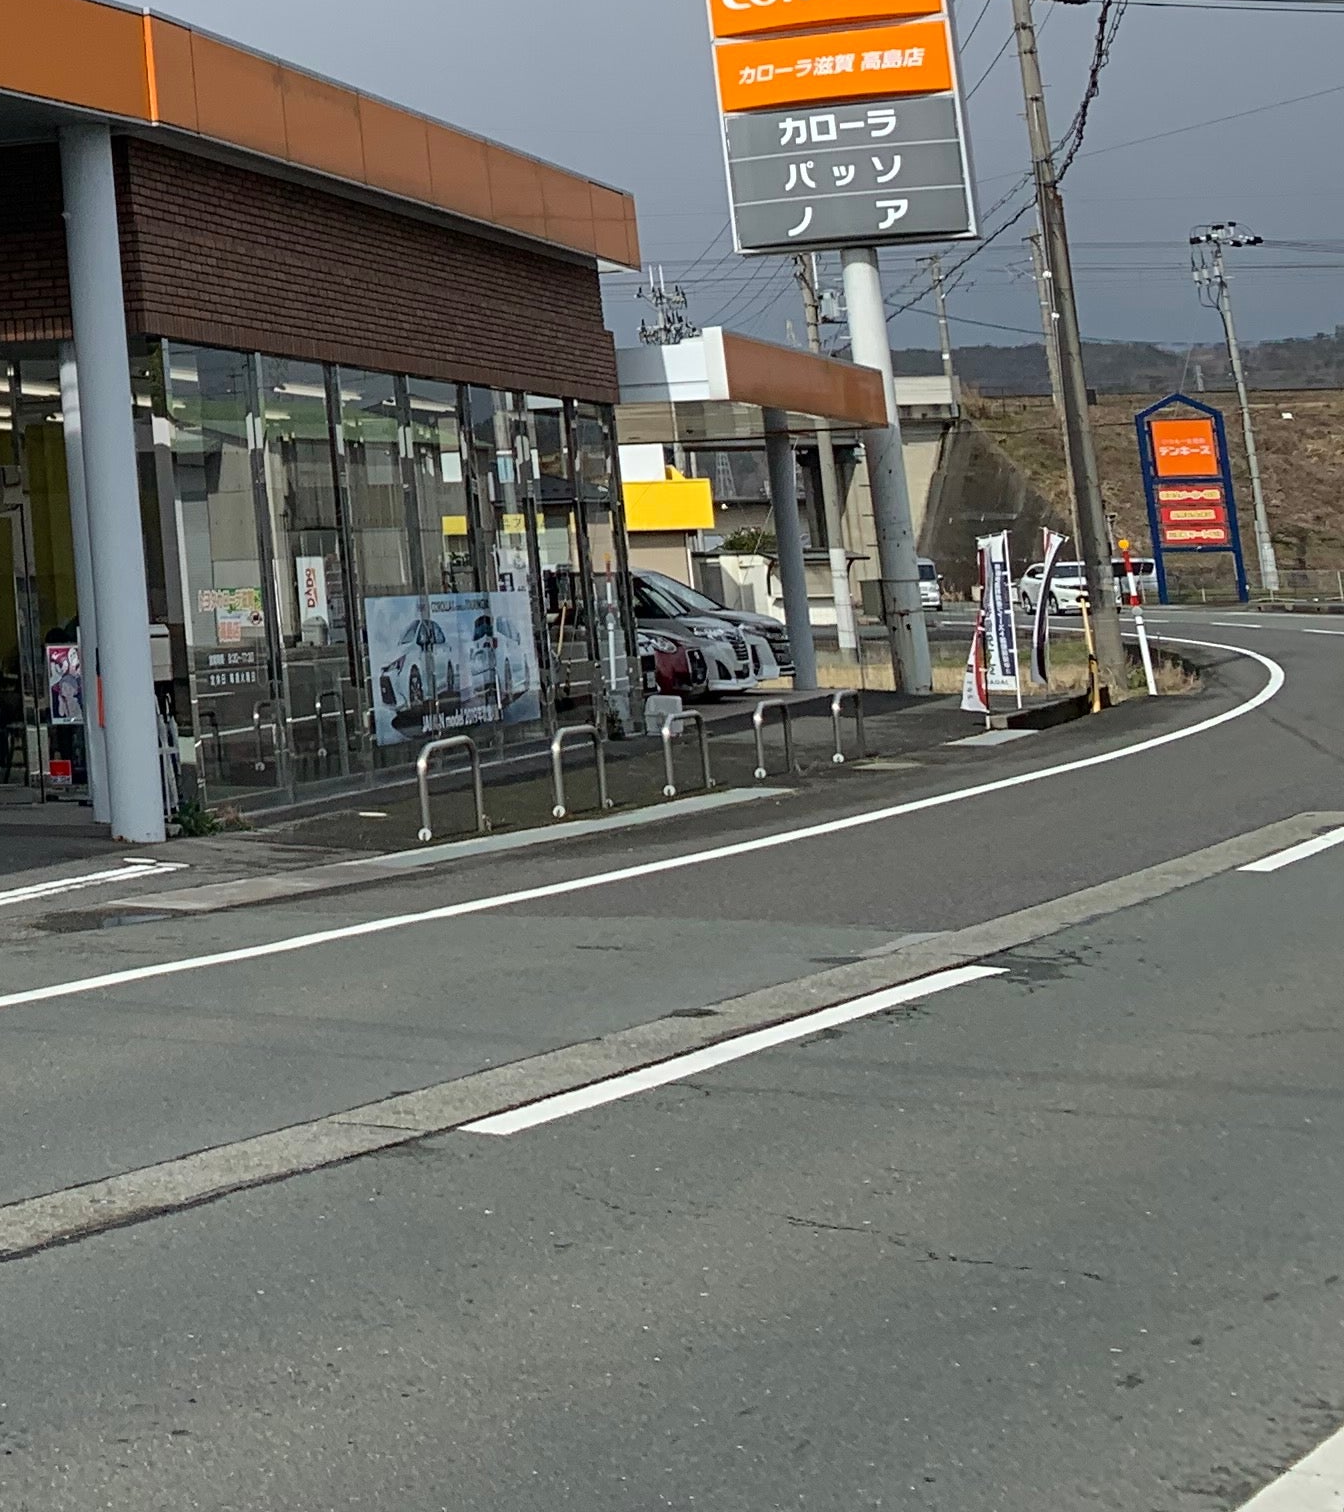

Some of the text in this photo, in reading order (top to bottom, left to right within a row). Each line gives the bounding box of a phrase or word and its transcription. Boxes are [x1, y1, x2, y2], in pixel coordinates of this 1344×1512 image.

[739, 47, 926, 85] カローラ滋賀 高島店
[779, 108, 897, 146] カローラ
[785, 155, 901, 192] パッソ
[787, 199, 909, 237] ノア
